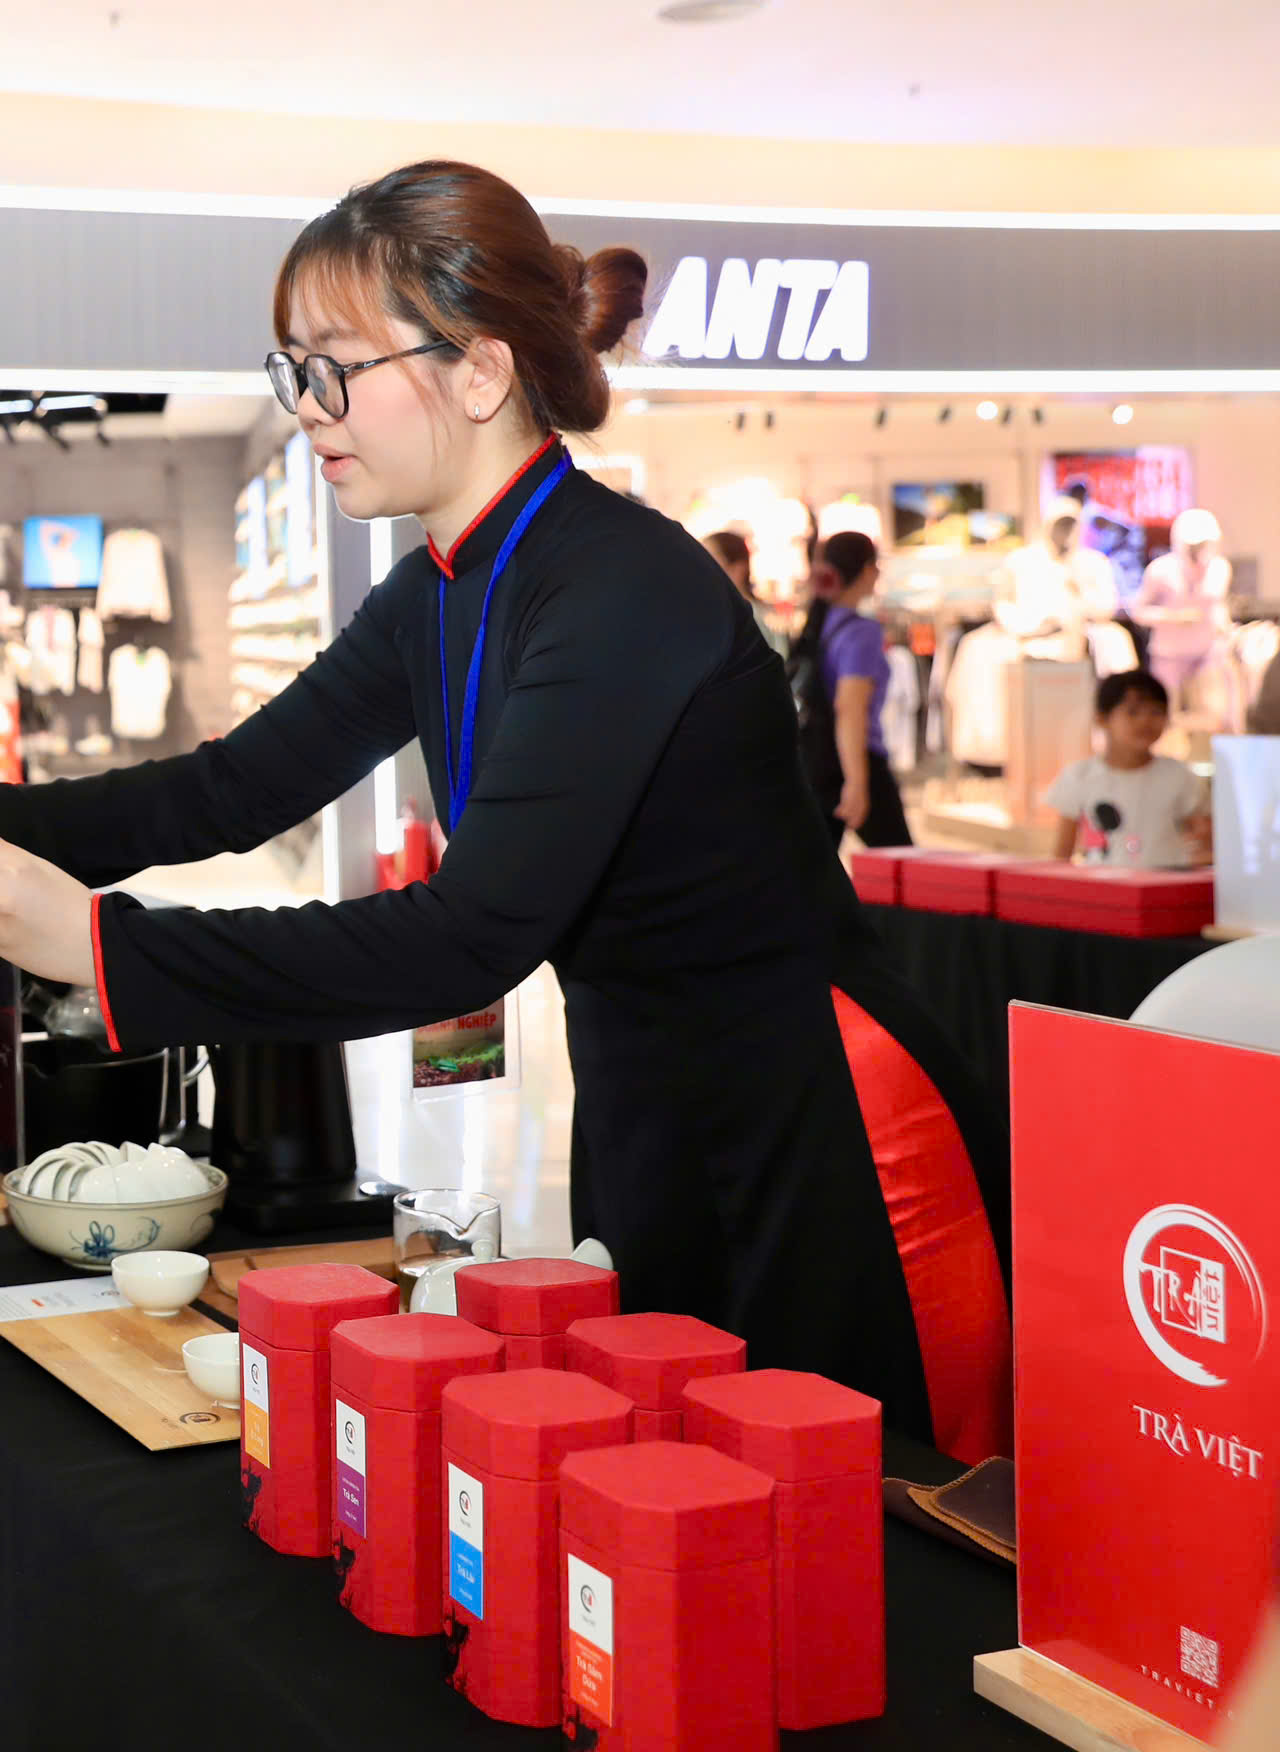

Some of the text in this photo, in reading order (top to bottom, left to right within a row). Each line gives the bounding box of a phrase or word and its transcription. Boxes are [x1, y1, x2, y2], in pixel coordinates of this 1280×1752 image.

[641, 256, 870, 361] ANTA
[1133, 1404, 1264, 1480] TRÀ VIỆT
